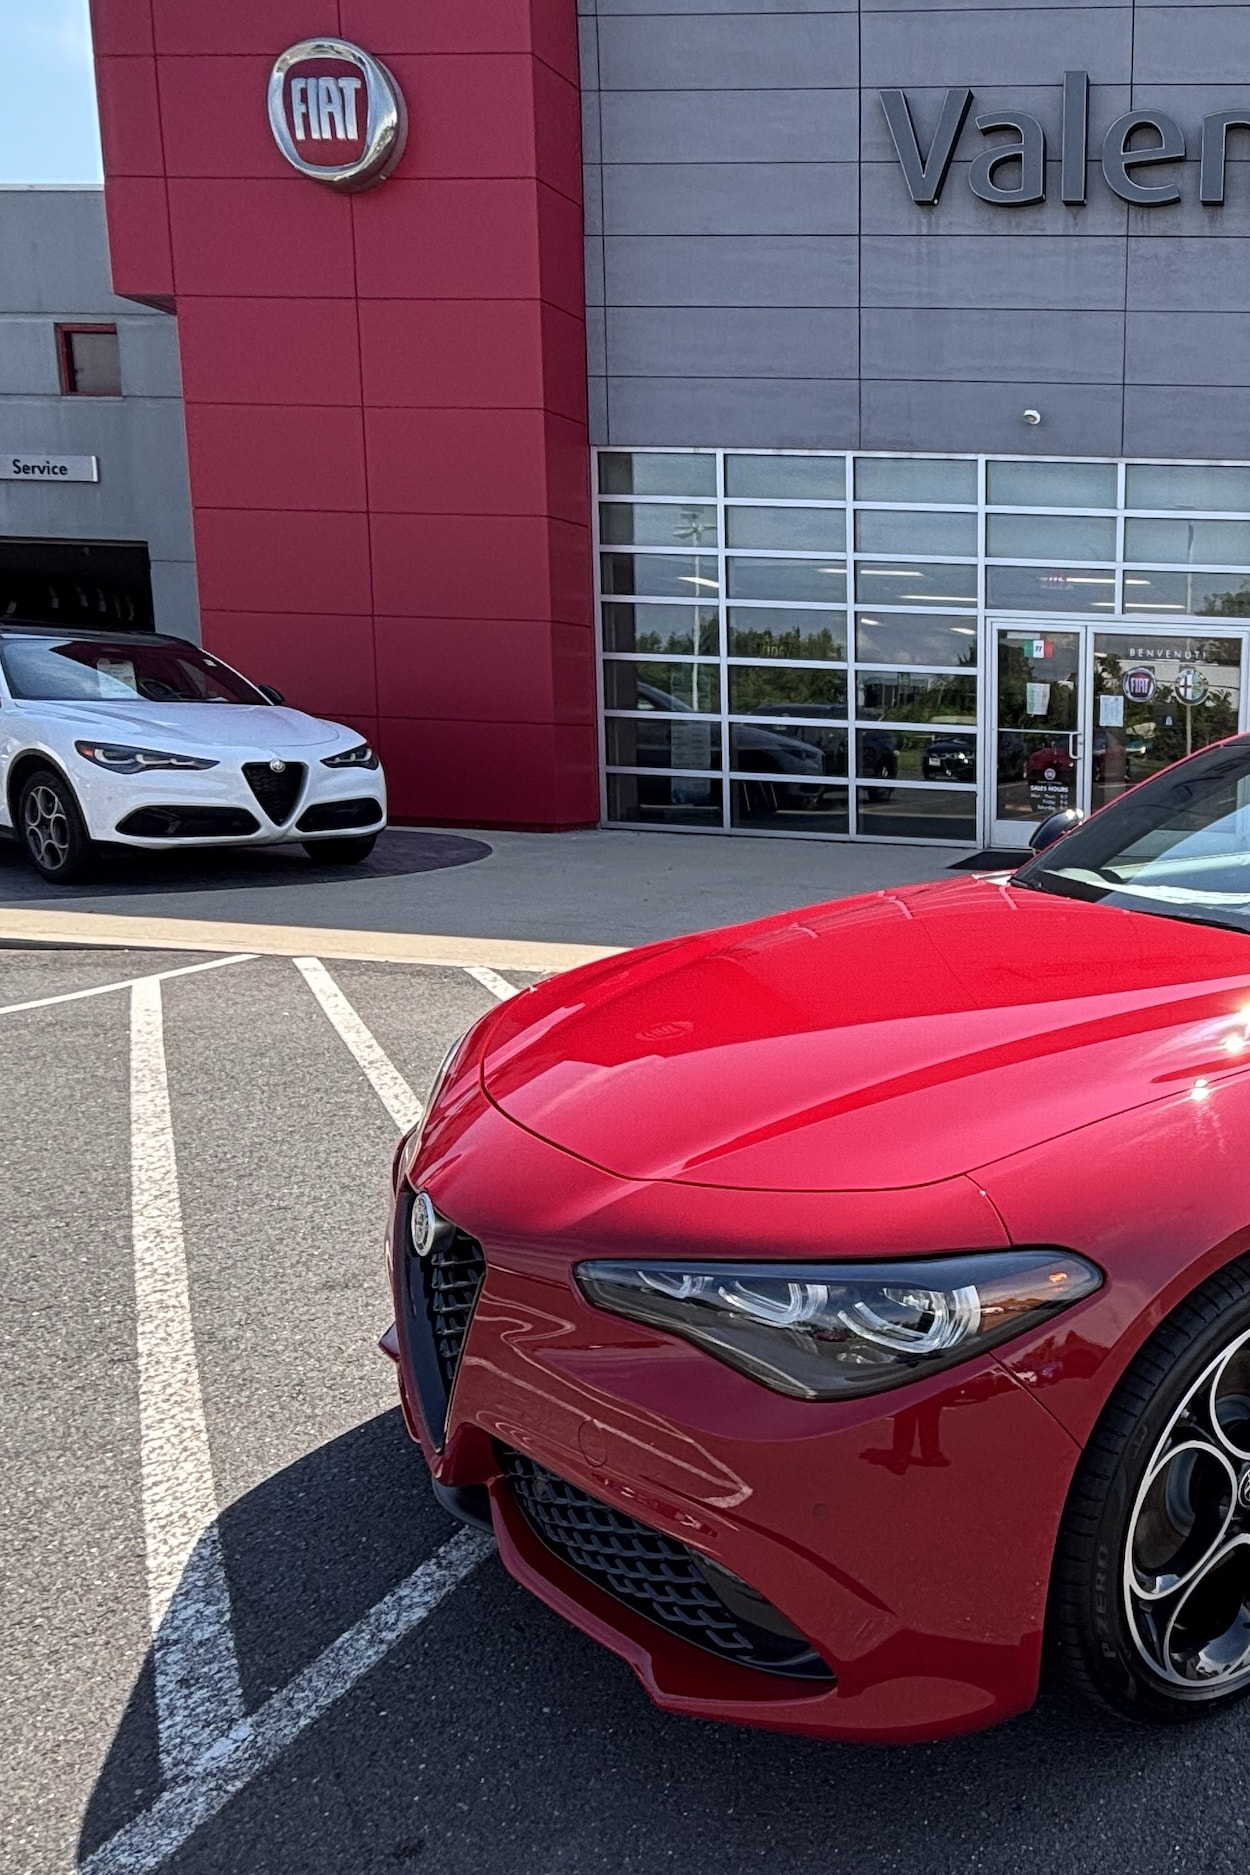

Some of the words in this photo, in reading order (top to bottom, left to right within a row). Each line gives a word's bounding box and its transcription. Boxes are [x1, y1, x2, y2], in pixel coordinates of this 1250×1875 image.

[290, 76, 362, 142] FIAT
[12, 459, 68, 476] Service
[1129, 648, 1206, 660] BENVENUTI
[1130, 677, 1150, 694] FIAT
